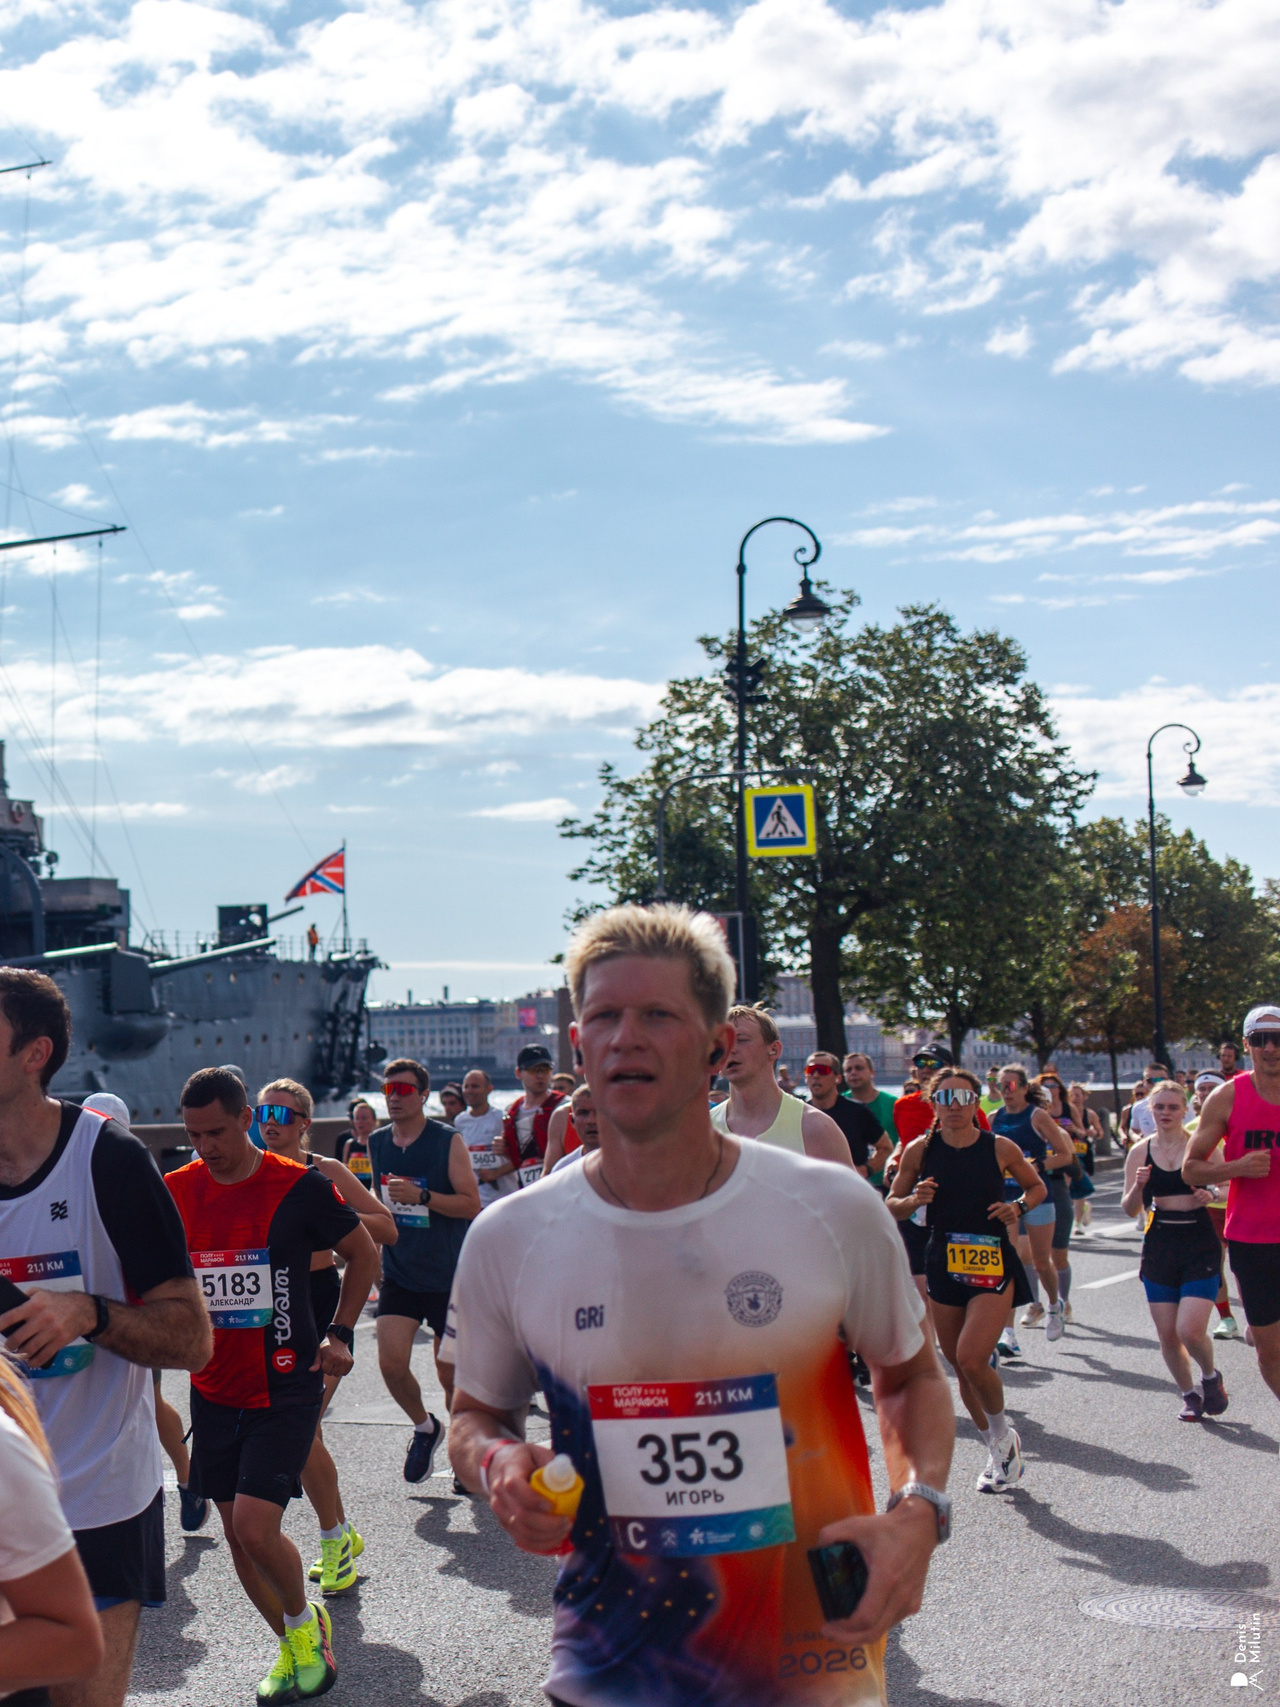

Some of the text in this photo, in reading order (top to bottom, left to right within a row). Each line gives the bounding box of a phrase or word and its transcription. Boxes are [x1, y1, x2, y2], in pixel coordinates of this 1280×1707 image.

[1245, 1130, 1280, 1149] IR
[949, 1248, 1000, 1266] 11285
[27, 1263, 44, 1273] 21,1
[202, 1272, 261, 1297] 5183
[210, 1298, 255, 1306] АЛЕКСАНДР
[274, 1267, 291, 1345] team
[575, 1305, 604, 1330] GRi
[612, 1386, 643, 1397] ПОЛУ
[695, 1391, 723, 1406] 21,1
[613, 1396, 669, 1408] МАРАФОН
[637, 1430, 744, 1485] 353
[666, 1489, 725, 1505] ИГОРЬ
[627, 1522, 648, 1549] C
[778, 1647, 868, 1678] 2026
